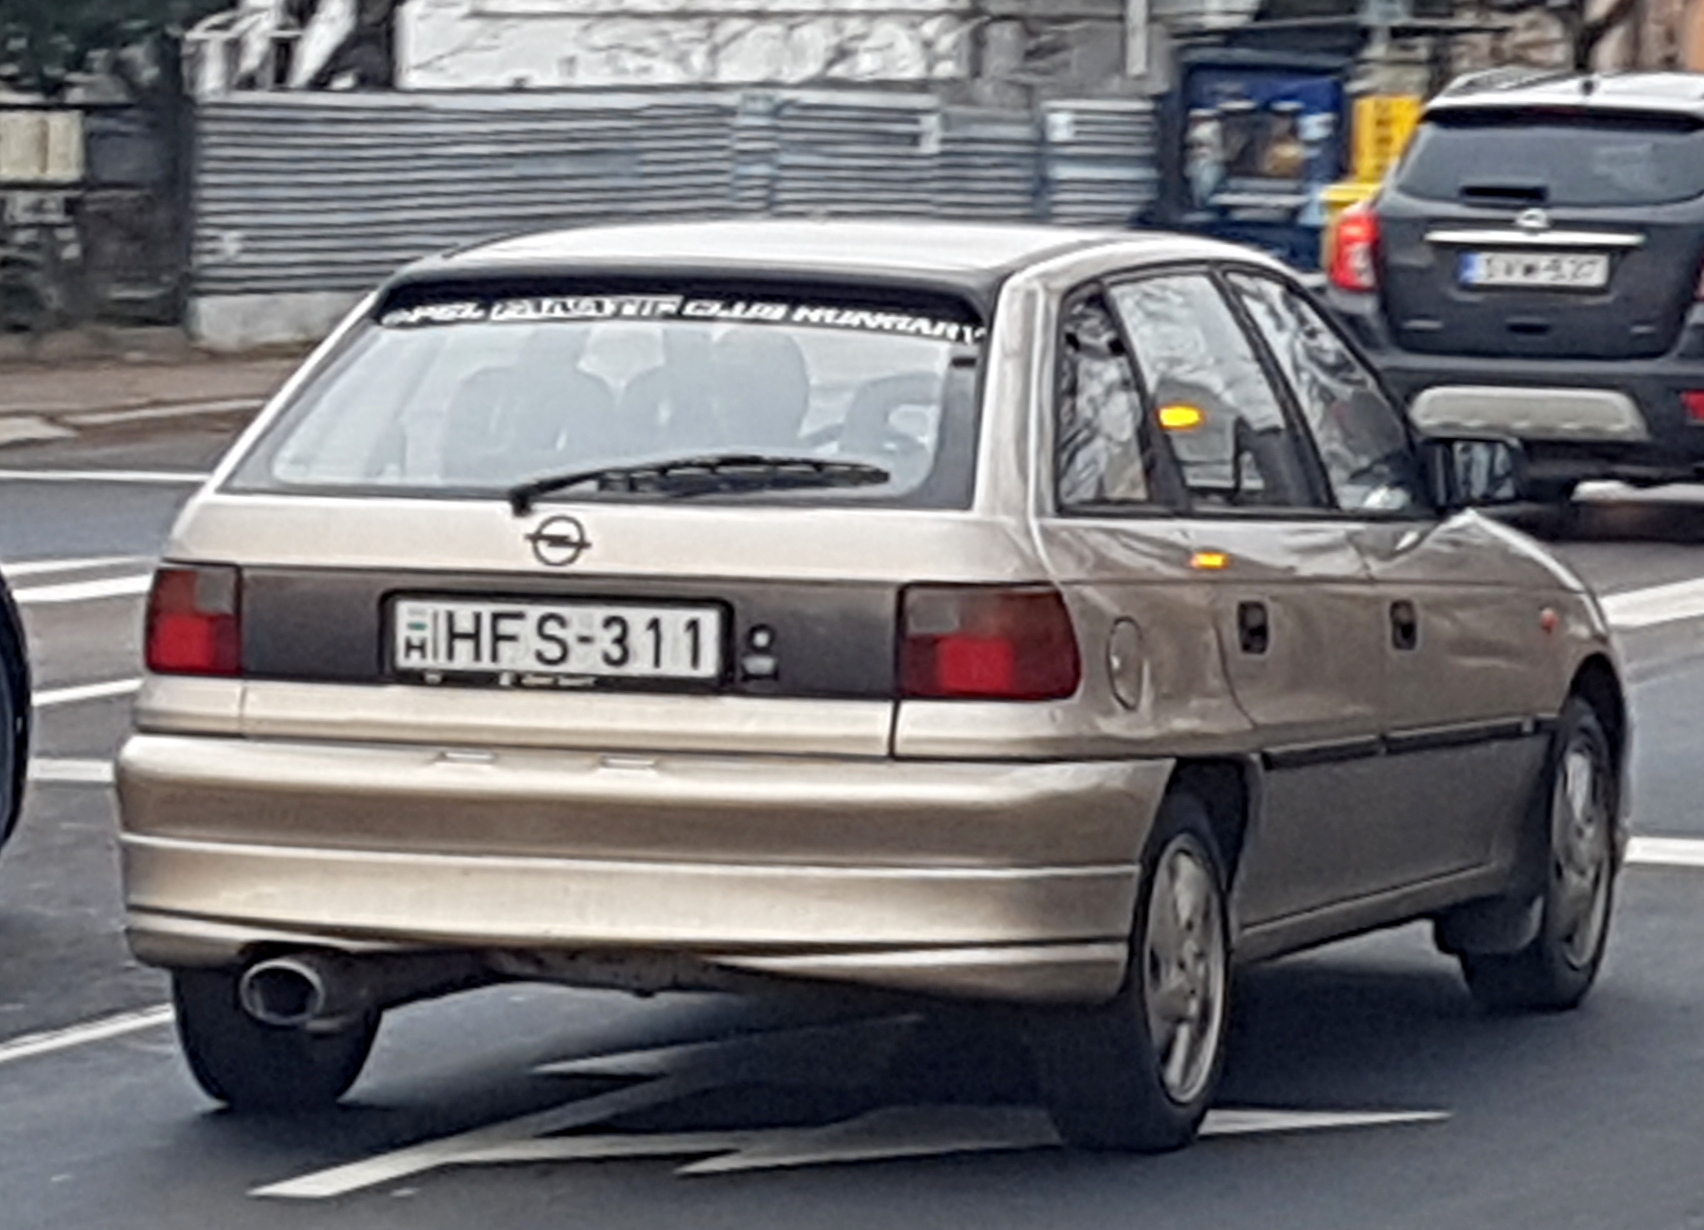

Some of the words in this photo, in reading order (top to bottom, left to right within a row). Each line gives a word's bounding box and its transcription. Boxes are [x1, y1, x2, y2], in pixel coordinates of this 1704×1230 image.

[381, 302, 485, 327] OPEL
[682, 301, 788, 320] CLUB
[792, 305, 986, 344] HUNGARY
[404, 635, 427, 659] H
[445, 609, 701, 670] HFS-311
